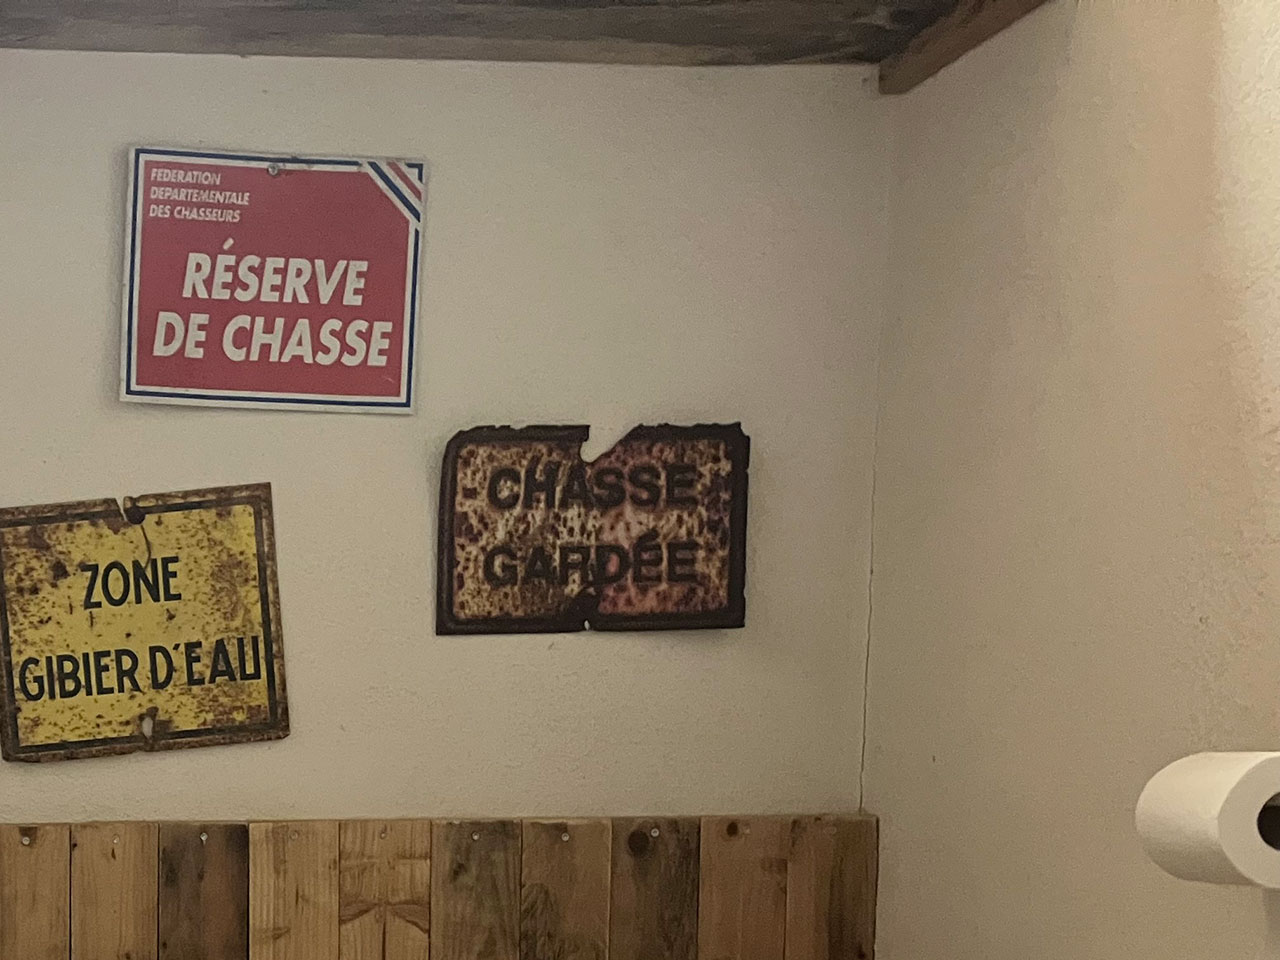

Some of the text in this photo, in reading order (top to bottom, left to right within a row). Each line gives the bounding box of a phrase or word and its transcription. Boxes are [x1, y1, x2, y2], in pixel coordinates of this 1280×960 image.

[149, 186, 251, 206] DEPARTEMENTALE
[150, 168, 221, 185] FEDERATION
[149, 204, 241, 223] DES CHASSEURS
[182, 237, 369, 307] RÉSERVE
[152, 311, 393, 367] DE CHASSE
[487, 455, 699, 510] CHASSE
[80, 555, 182, 610] ZONE
[483, 529, 700, 587] GARDÉE
[19, 635, 262, 701] GIBIER D'EAU
